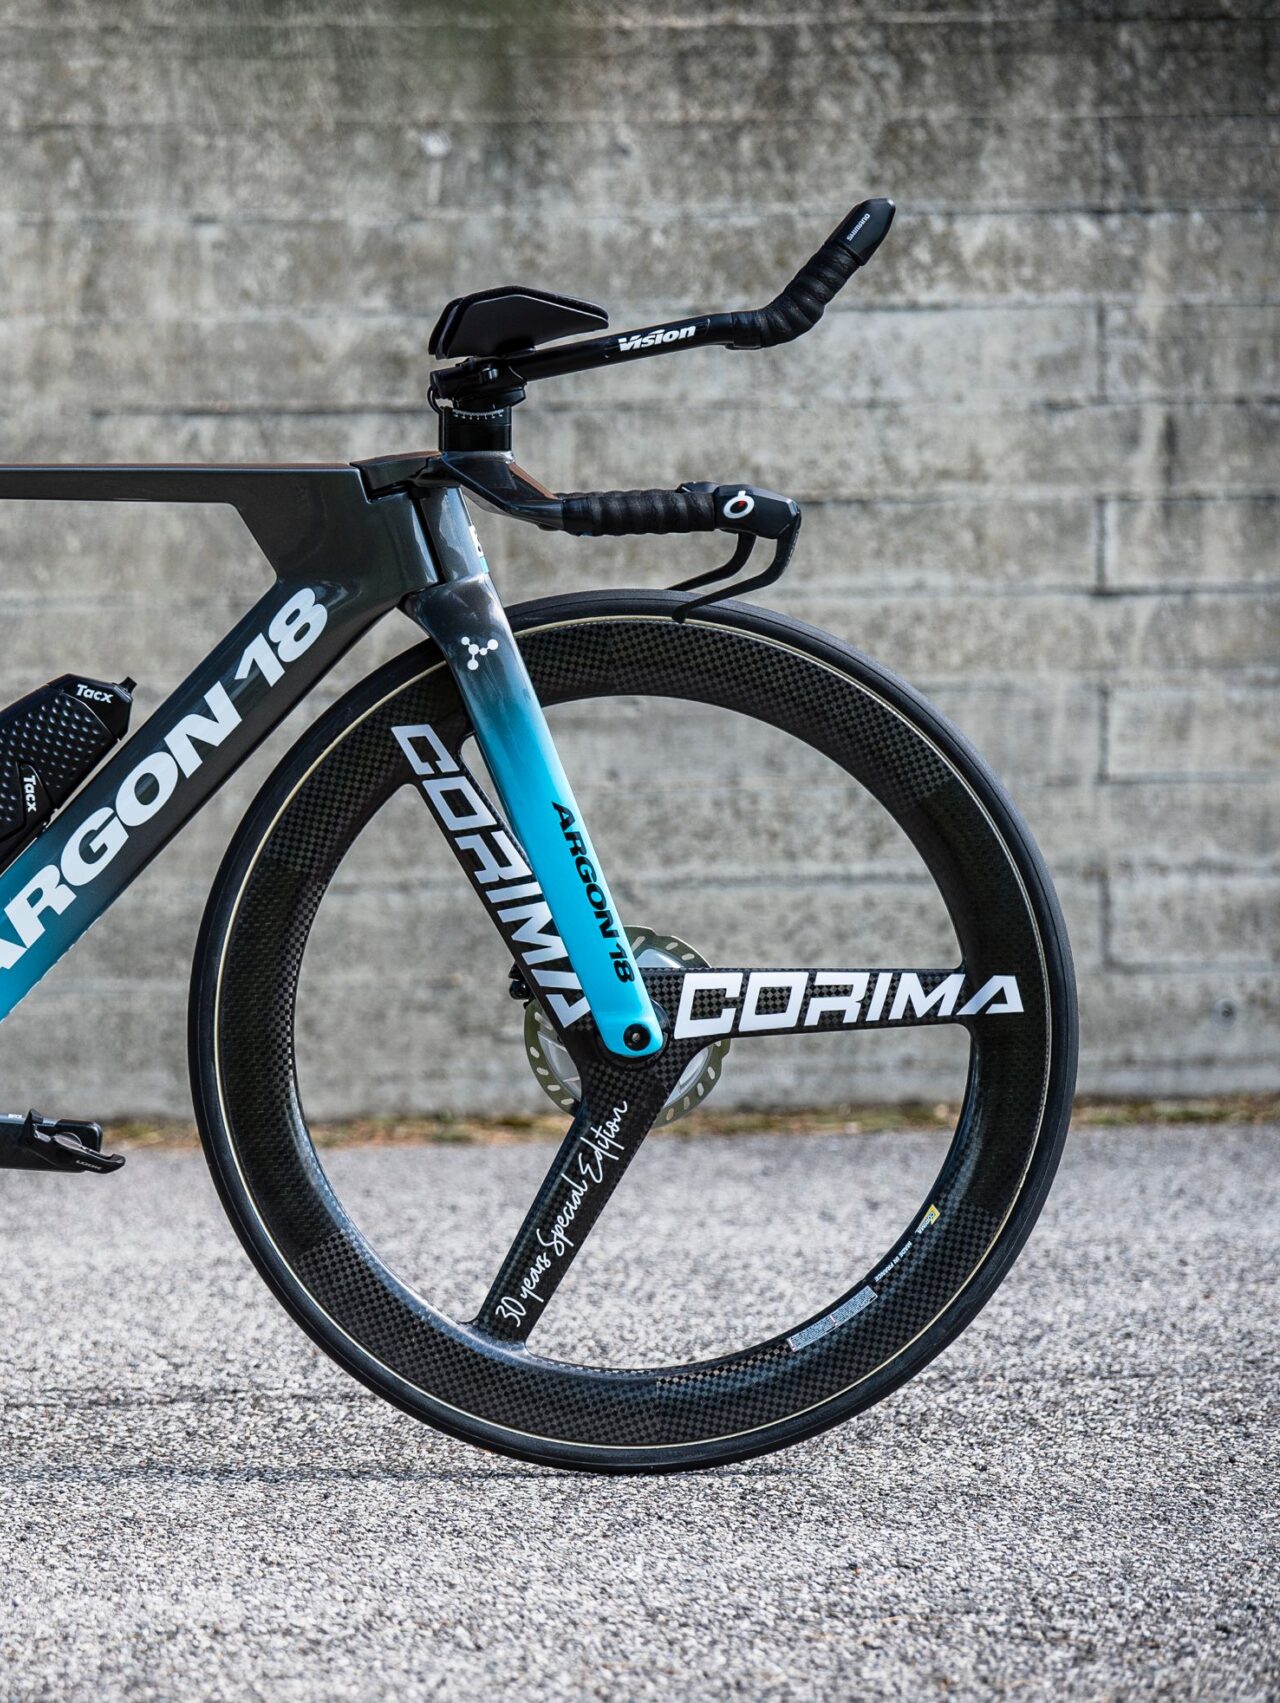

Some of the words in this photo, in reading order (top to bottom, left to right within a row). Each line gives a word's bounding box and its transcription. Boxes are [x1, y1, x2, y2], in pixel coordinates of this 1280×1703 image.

[846, 212, 870, 241] SHIMANO
[618, 325, 697, 352] Vision
[234, 587, 328, 688] 18
[76, 683, 115, 705] Tacx
[23, 774, 37, 813] Tacx
[552, 801, 620, 940] ARGON
[608, 942, 636, 985] 18
[673, 971, 1025, 1040] CORIMA
[495, 1296, 527, 1328] 30
[520, 1252, 551, 1303] years
[536, 1173, 588, 1257] Special
[578, 1101, 628, 1184] Edition
[892, 1255, 900, 1264] IN
[898, 1240, 912, 1258] MADE
[874, 1263, 894, 1283] FRANCE
